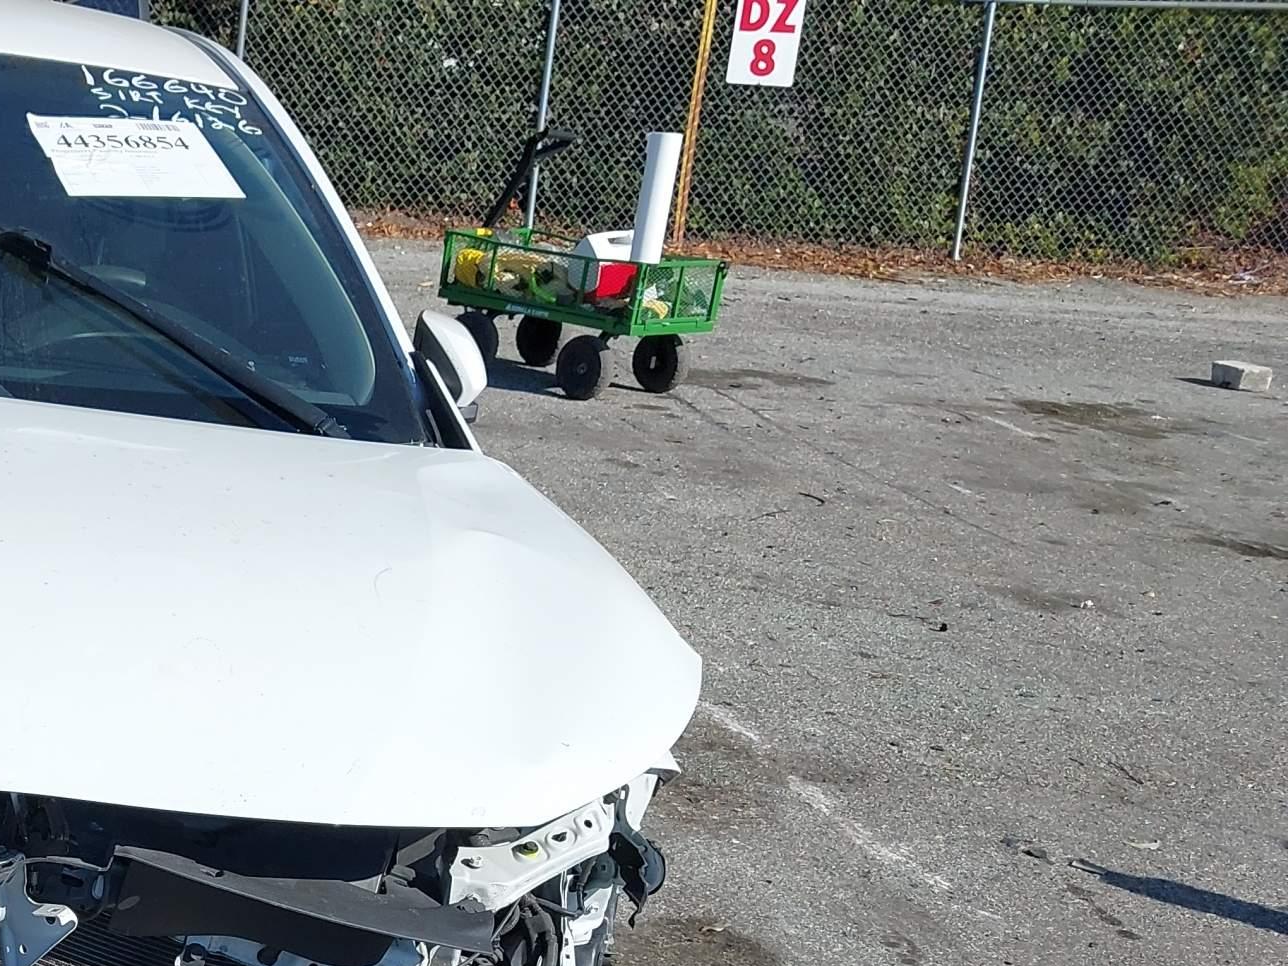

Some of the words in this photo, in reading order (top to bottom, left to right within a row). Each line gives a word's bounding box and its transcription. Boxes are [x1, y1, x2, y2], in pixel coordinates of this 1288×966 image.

[740, 0, 798, 33] DZ
[750, 39, 776, 76] 8
[56, 133, 190, 150] 44356854
